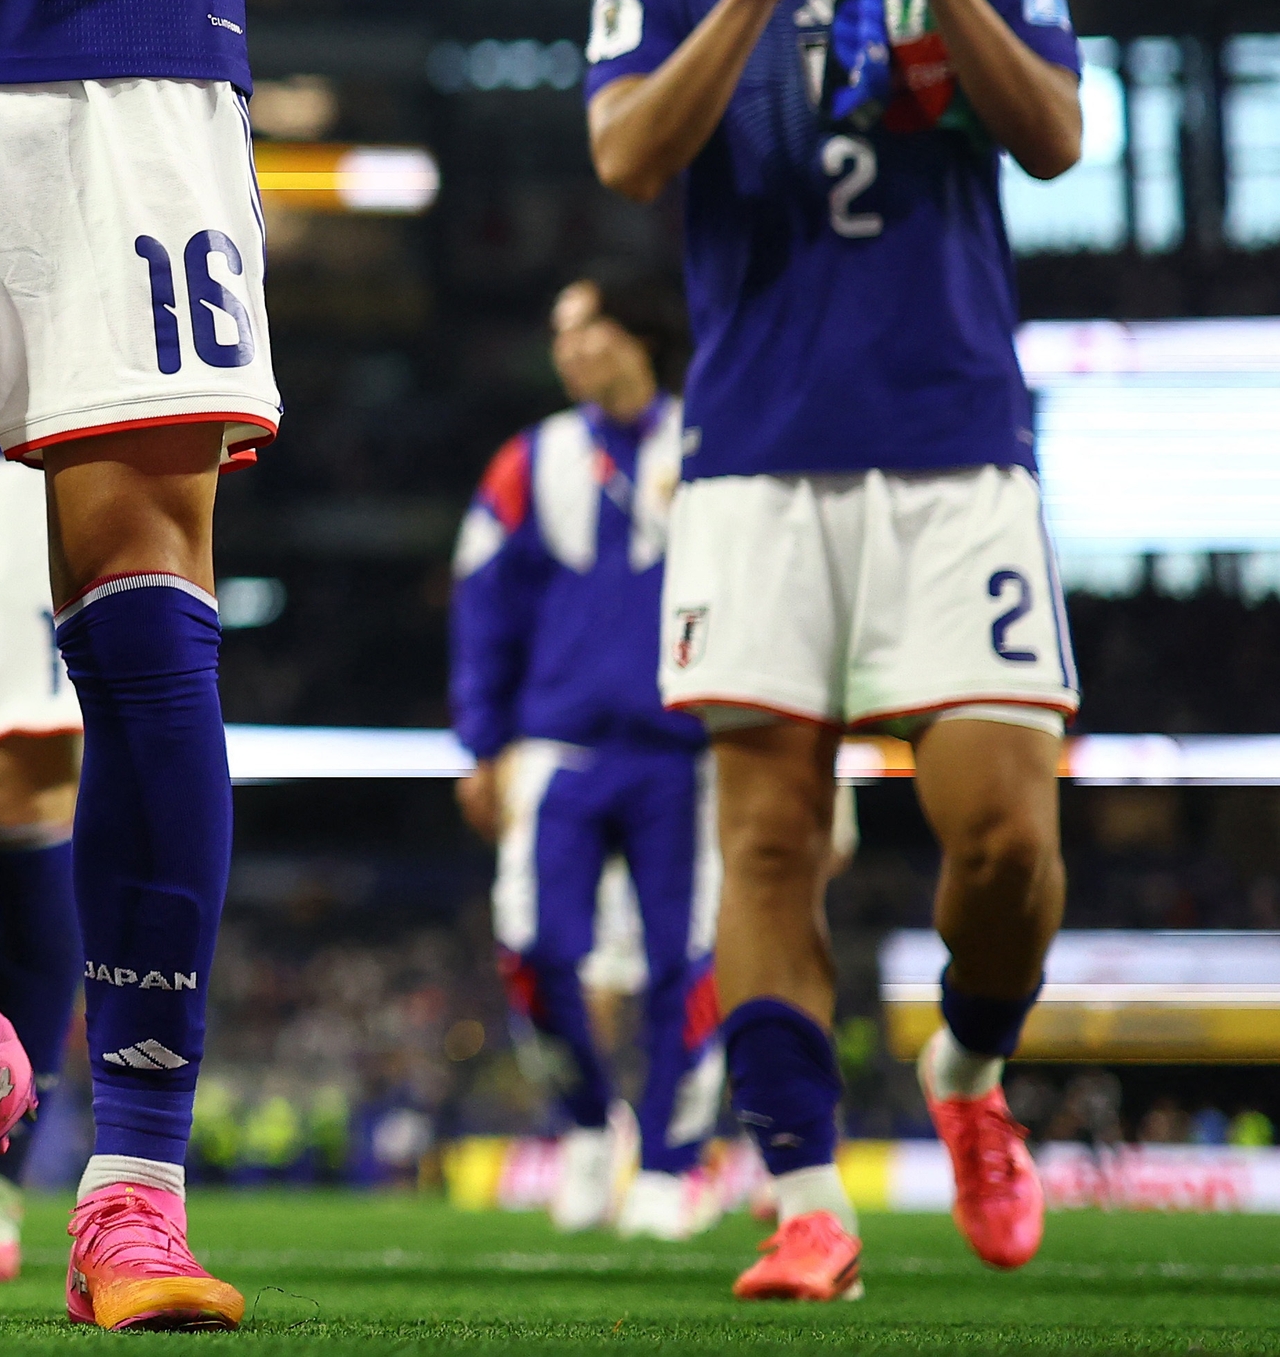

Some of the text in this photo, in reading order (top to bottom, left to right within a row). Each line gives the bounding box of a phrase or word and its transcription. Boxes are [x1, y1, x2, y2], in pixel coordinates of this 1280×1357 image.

[822, 134, 884, 239] 2
[135, 229, 255, 375] 16
[988, 569, 1038, 663] 2
[84, 960, 197, 991] JAPAN
